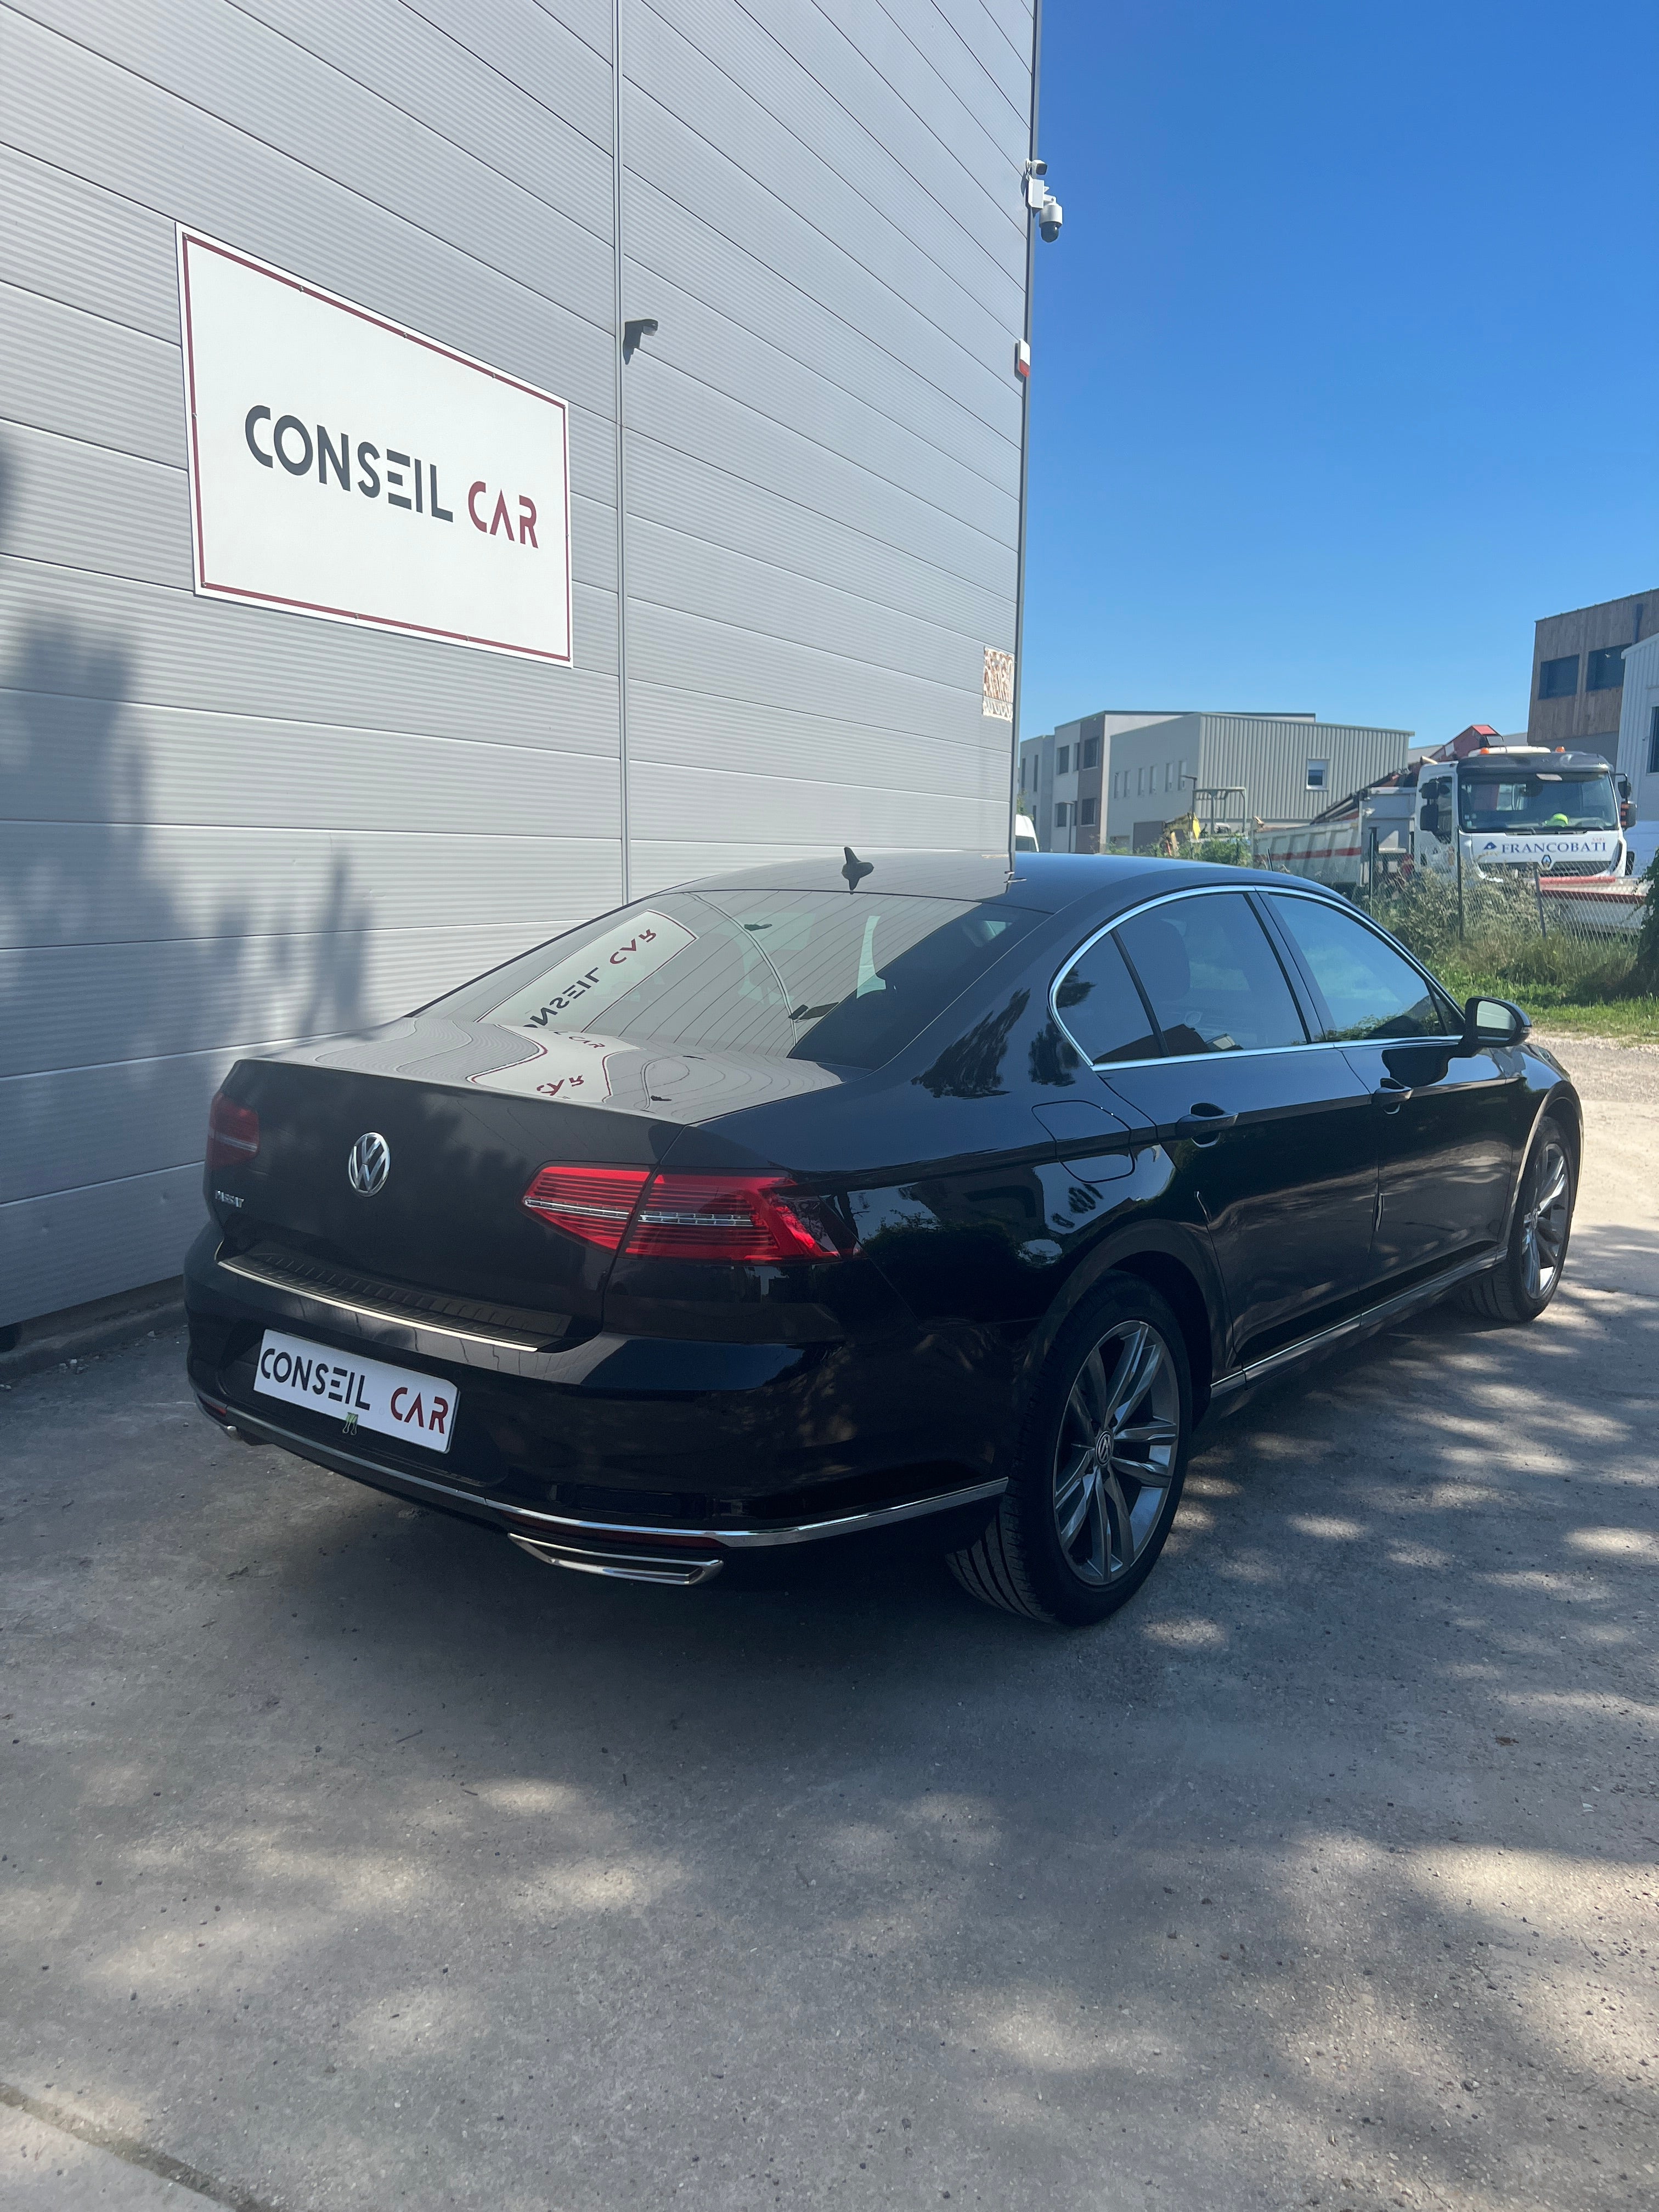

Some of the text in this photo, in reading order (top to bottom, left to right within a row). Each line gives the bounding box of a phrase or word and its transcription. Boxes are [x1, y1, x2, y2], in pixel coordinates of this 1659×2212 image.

[245, 405, 539, 549] CONSEIL CAR
[1502, 842, 1607, 854] FRANCOBATI
[261, 1348, 449, 1435] CONSEIL CAR
